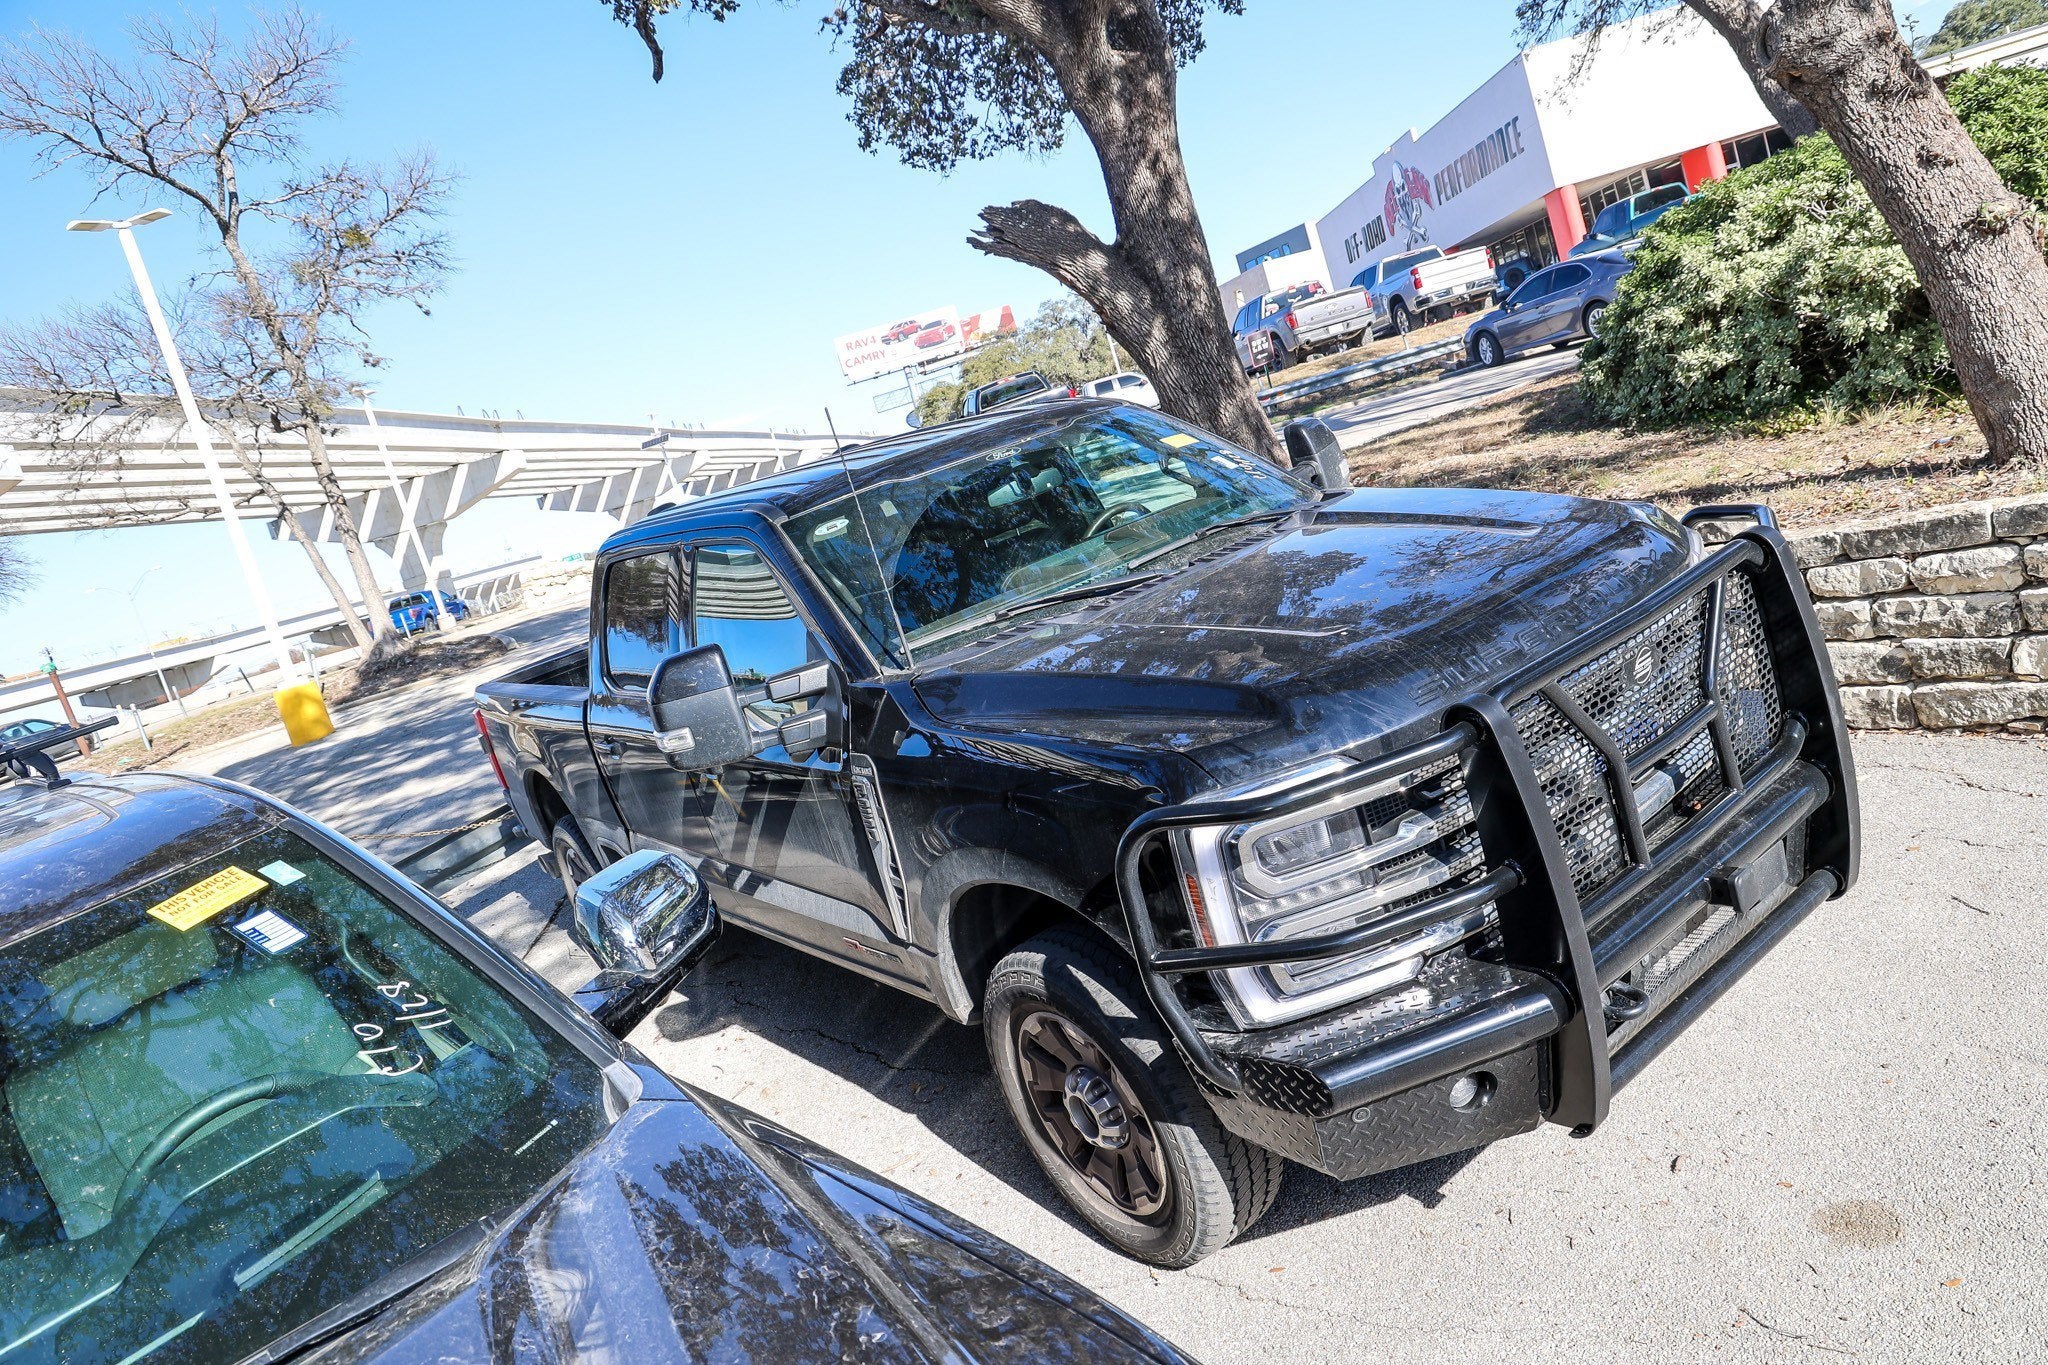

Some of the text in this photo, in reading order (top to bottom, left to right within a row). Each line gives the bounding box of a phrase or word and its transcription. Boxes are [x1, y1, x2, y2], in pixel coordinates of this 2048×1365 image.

[1344, 115, 1525, 264] OFF-ROAD PERFORMANCE
[845, 336, 876, 350] RAV4
[845, 350, 886, 368] CAMRY
[155, 896, 187, 913] THIS
[186, 868, 237, 897] VEHICLE
[169, 875, 243, 917] NOT FOR SALE
